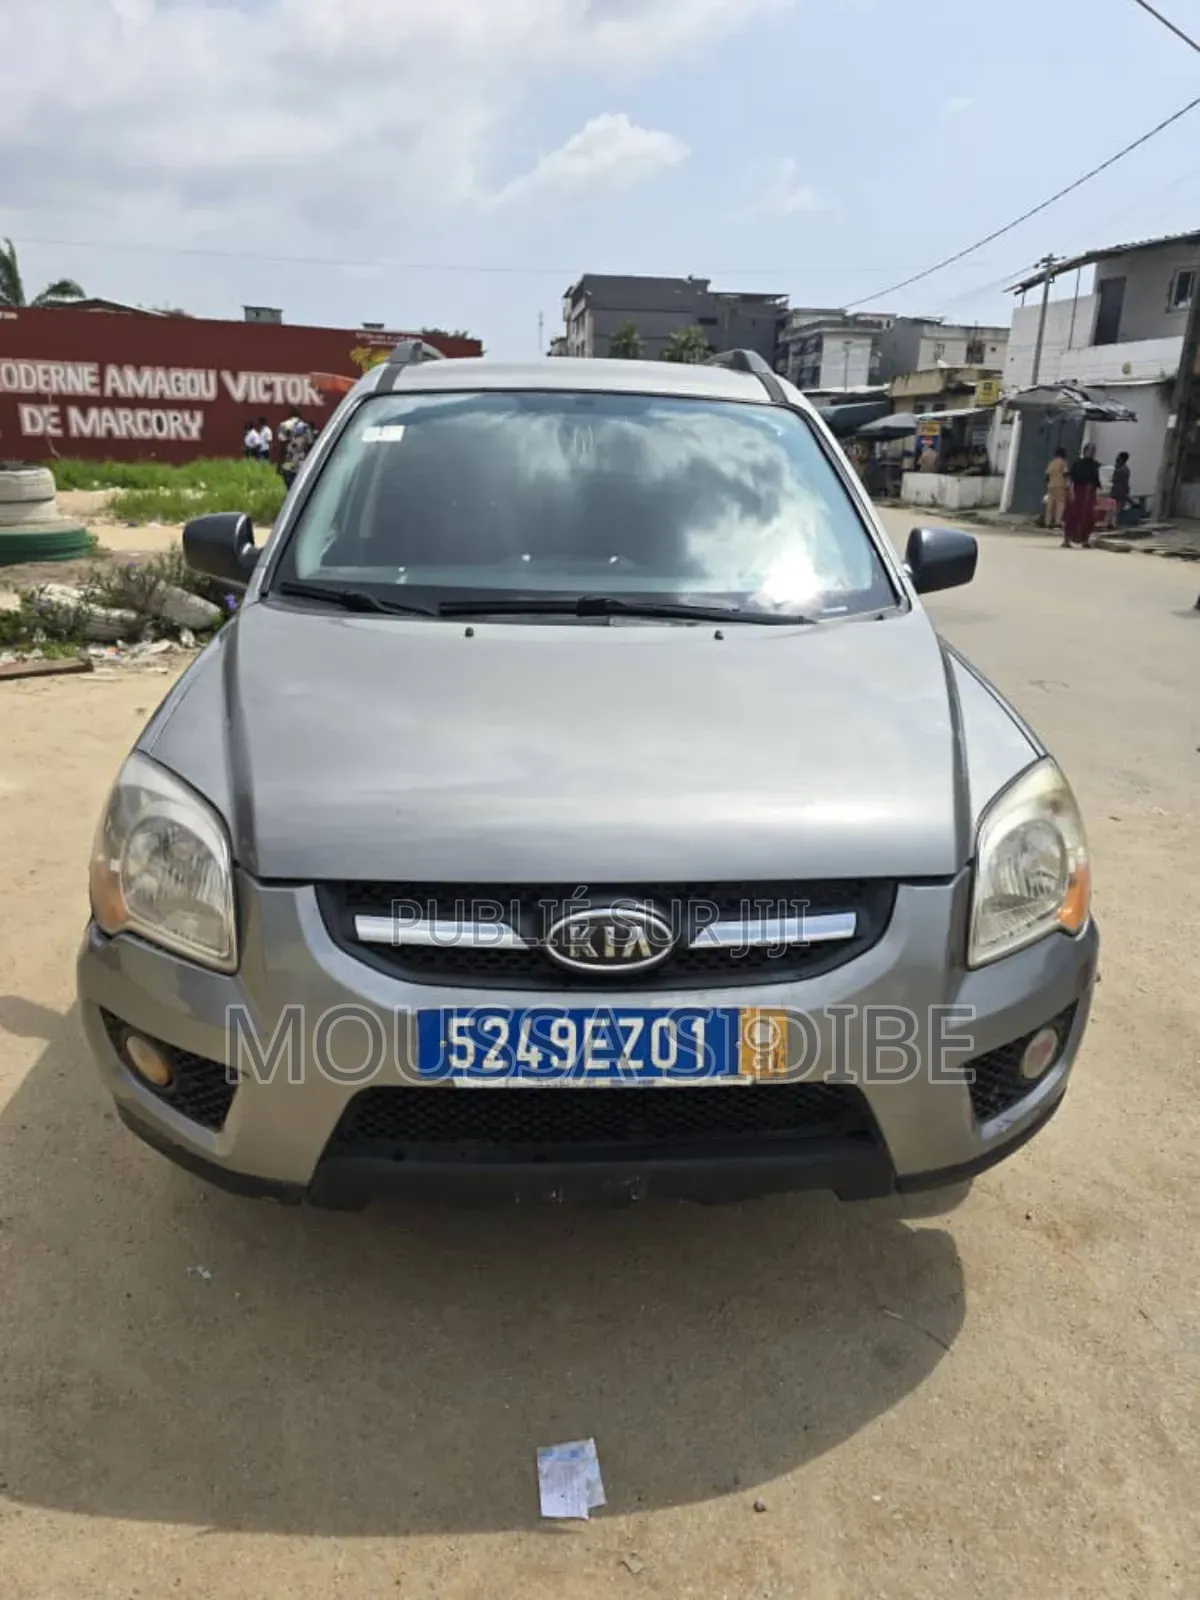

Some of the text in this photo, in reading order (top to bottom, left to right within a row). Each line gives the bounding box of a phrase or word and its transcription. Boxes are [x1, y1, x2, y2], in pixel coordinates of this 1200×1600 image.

[0, 358, 100, 396] ODERNE
[104, 363, 217, 401] AMAGOU
[18, 403, 204, 441] DE MARCORY
[568, 925, 653, 958] KIA
